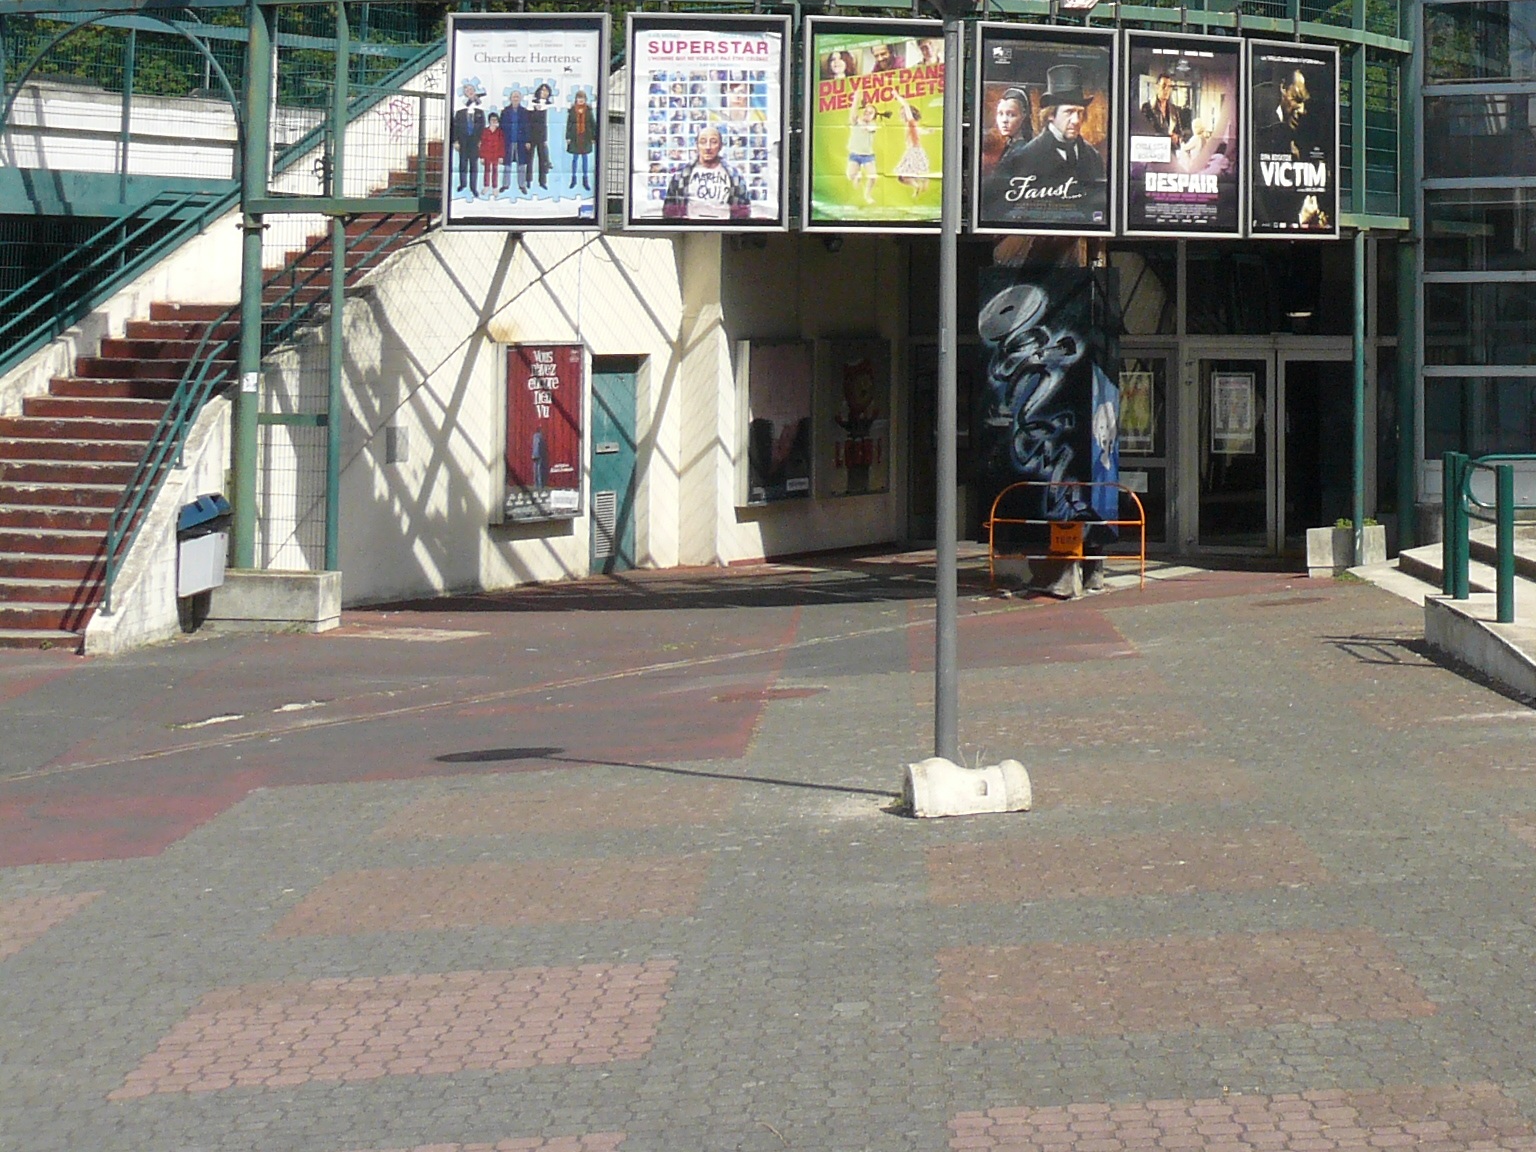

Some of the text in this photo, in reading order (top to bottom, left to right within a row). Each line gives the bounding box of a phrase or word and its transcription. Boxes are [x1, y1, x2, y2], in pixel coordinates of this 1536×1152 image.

[474, 51, 582, 64] Cherchez Hortense
[648, 40, 769, 55] SUPERSTAR
[819, 78, 846, 98] DU
[848, 70, 897, 91] VENT
[819, 91, 854, 113] MES
[1145, 171, 1219, 194] DESPAIR
[1260, 160, 1327, 188] VICTIM
[1005, 174, 1079, 202] Faust
